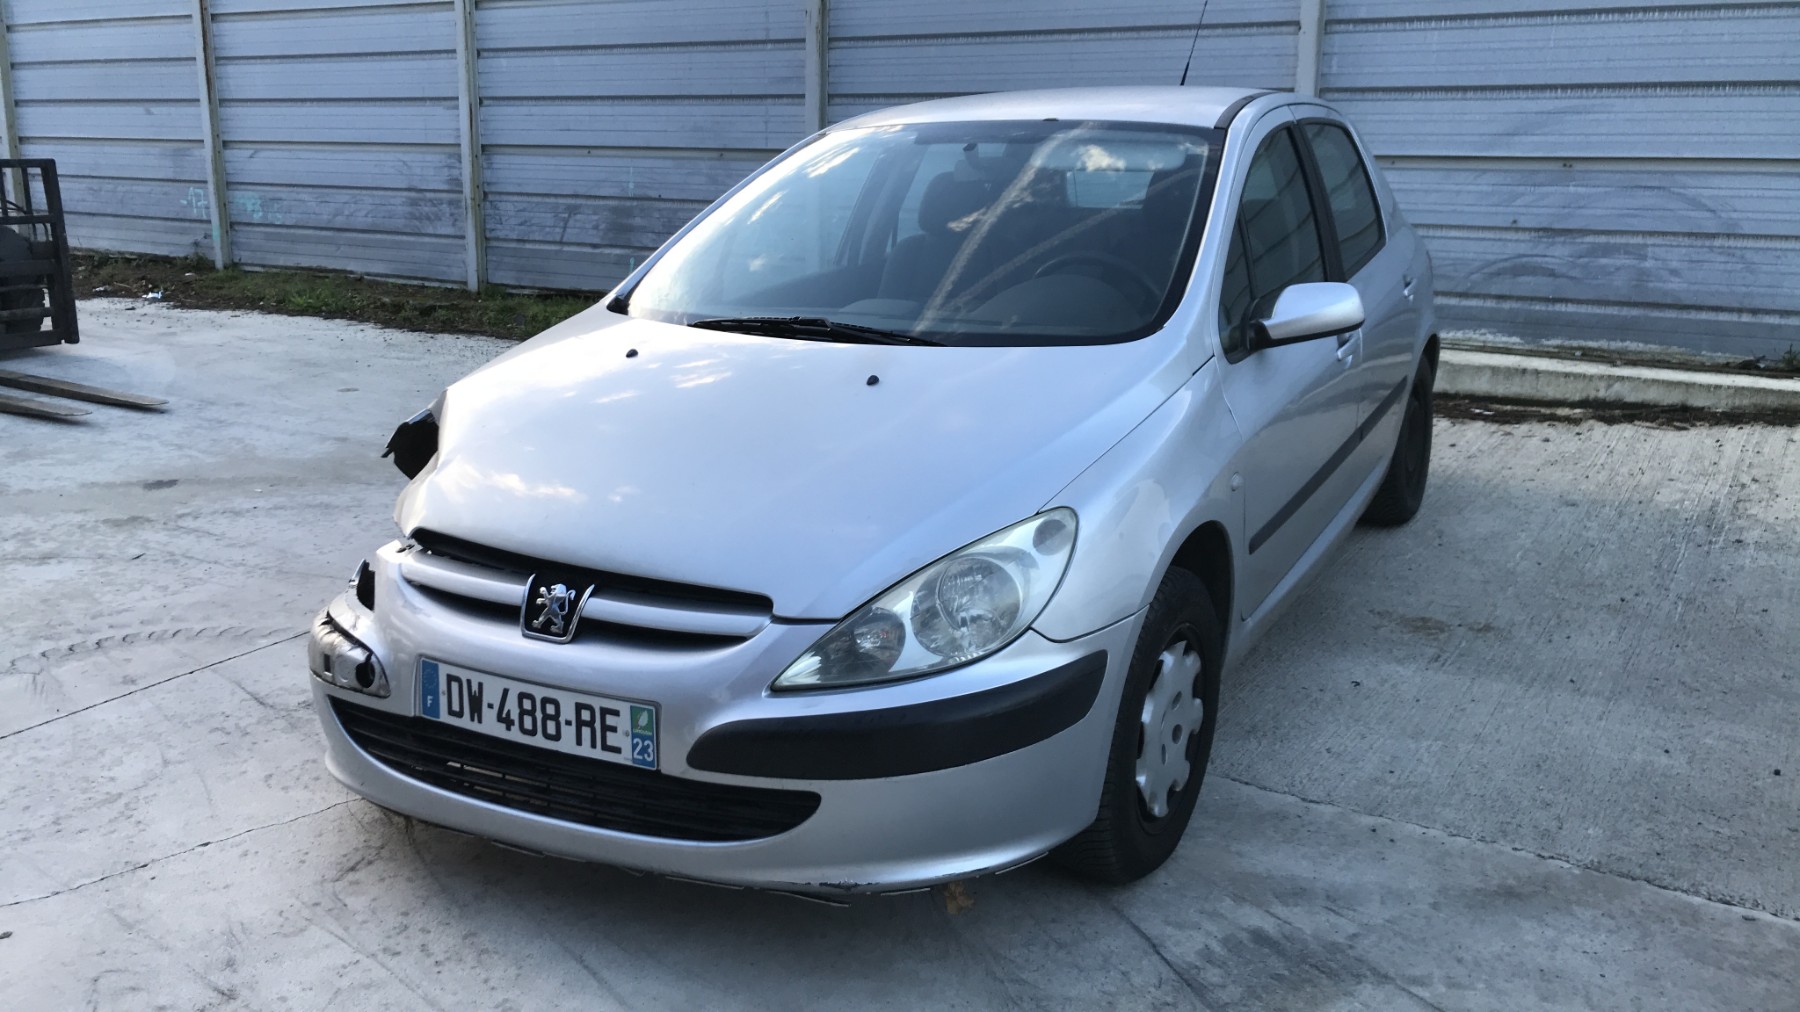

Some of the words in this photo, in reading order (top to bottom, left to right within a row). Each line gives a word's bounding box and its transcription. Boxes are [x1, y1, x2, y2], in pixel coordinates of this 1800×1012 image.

[427, 696, 433, 708] F
[446, 673, 622, 754] DW-488-RE
[633, 738, 654, 762] 23
